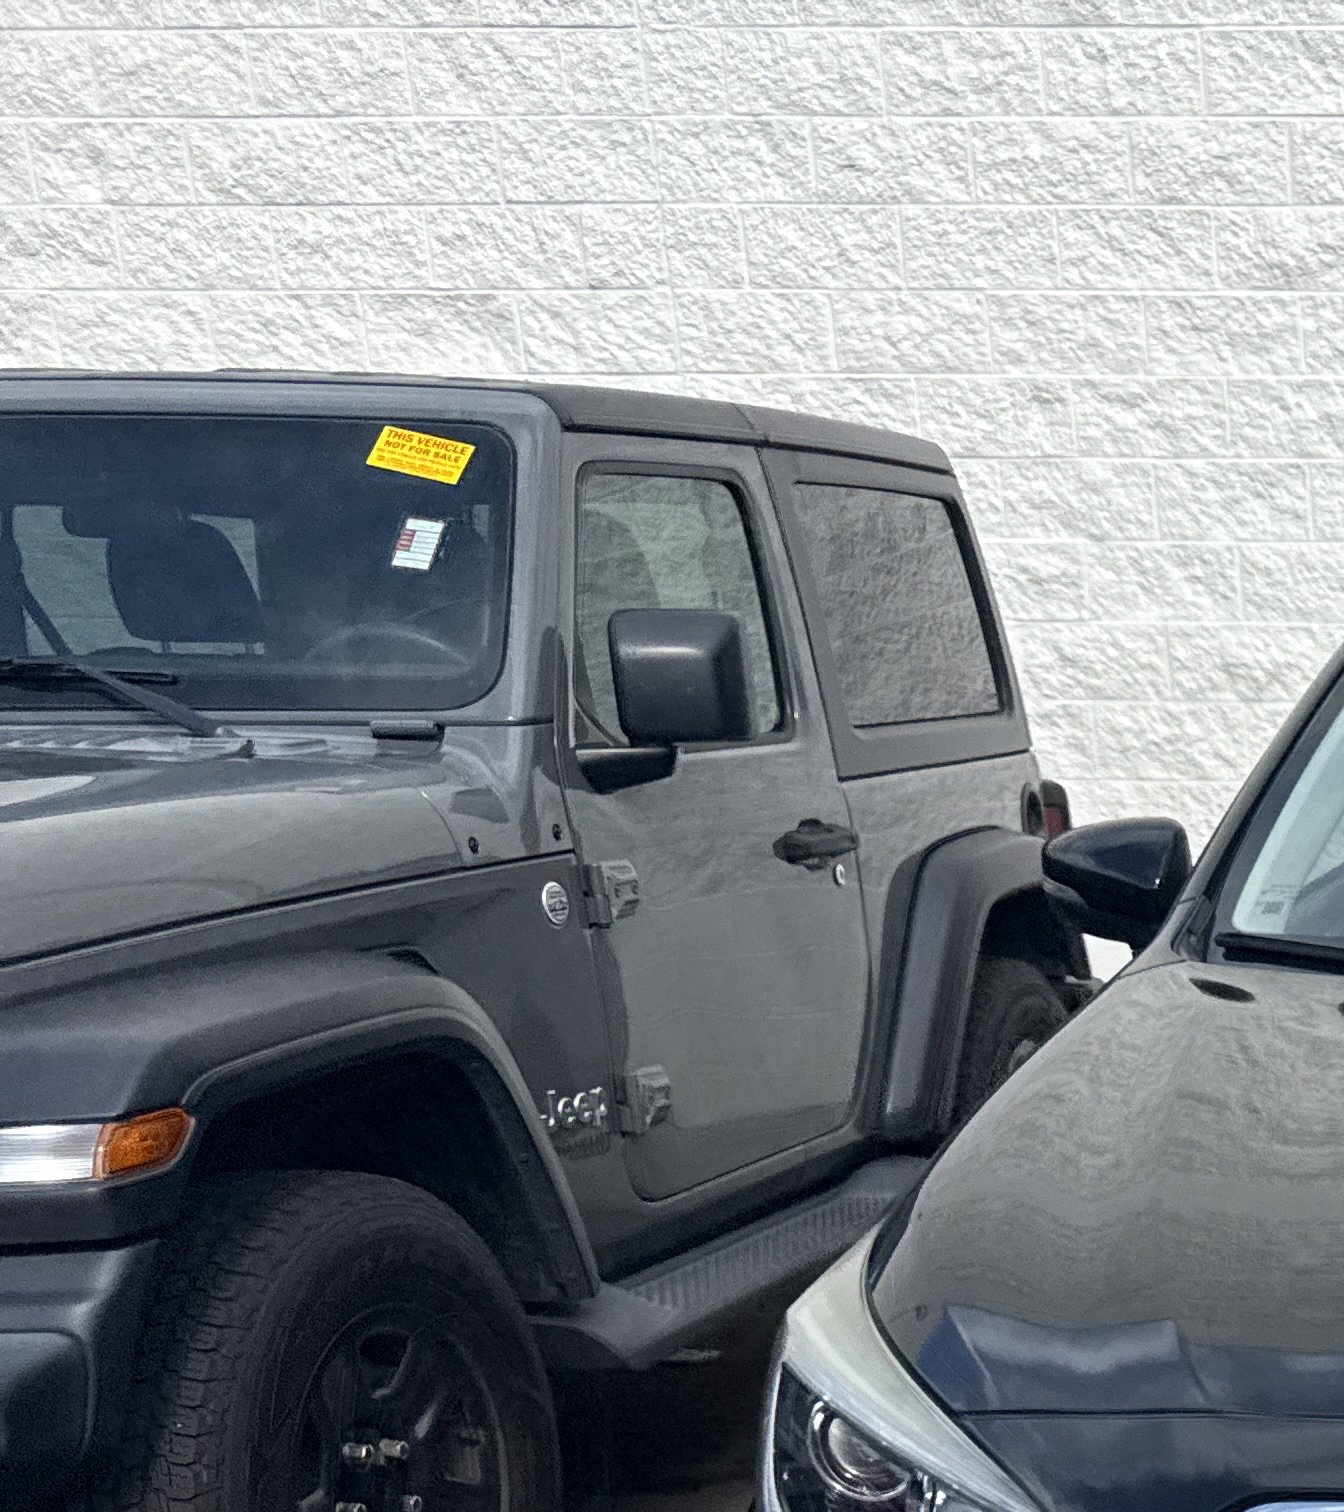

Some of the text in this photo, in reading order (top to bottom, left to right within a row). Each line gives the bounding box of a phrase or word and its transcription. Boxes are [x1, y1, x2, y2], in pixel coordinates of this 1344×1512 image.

[384, 440, 461, 463] NOT FOR SALE
[387, 429, 470, 456] THIS VEHICLE
[538, 1086, 608, 1128] Jeep
